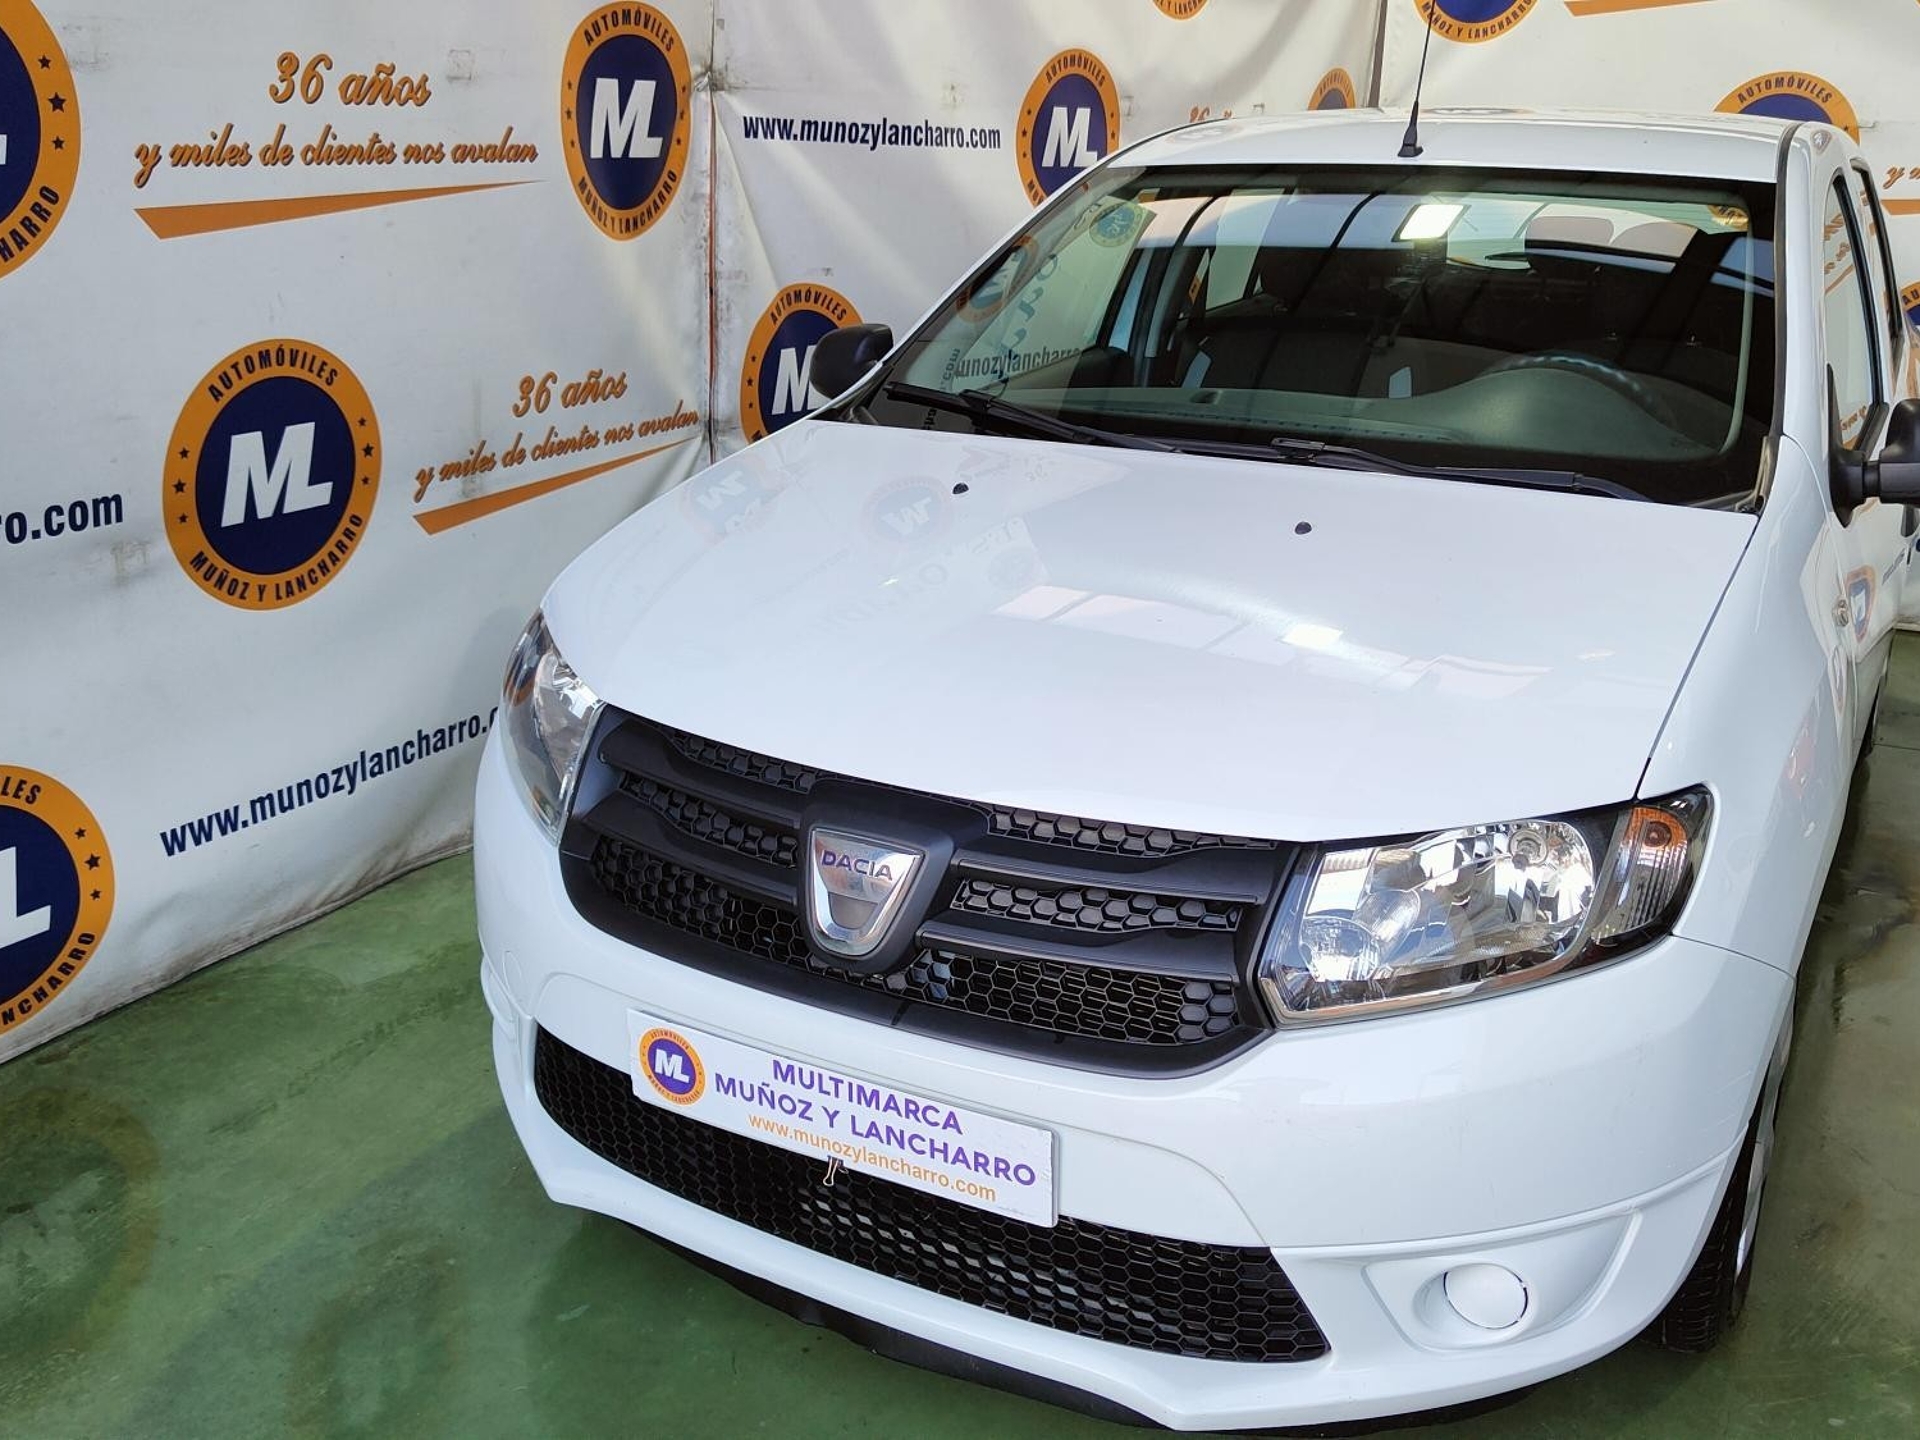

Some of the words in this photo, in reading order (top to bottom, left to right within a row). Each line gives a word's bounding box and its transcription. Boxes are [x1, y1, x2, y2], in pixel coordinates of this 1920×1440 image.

[584, 7, 674, 52] AUTOMÓVILES
[269, 51, 332, 104] 36
[338, 62, 431, 106] años
[1737, 74, 1832, 103] AUTOMÓVILES
[590, 77, 663, 159] ML
[743, 116, 1001, 151] www.munozylancharro.com
[1042, 106, 1098, 168] ML
[134, 142, 161, 188] y
[170, 122, 251, 167] miles
[259, 123, 293, 166] de
[300, 123, 397, 166] clientes
[403, 140, 445, 165] nos
[450, 125, 538, 164] avalan
[770, 286, 847, 326] AUTOMÓVILES
[208, 344, 339, 402] AUTOMÓVILES
[512, 372, 557, 417] 36
[561, 369, 627, 409] años
[221, 421, 333, 528] ML
[413, 465, 434, 502] y
[439, 439, 497, 481] miles
[502, 432, 526, 468] de
[531, 426, 600, 461] clientes
[604, 425, 635, 446] nos
[638, 399, 699, 438] avalan
[0, 494, 123, 544] o.com
[189, 551, 250, 601] MUÑOZ
[257, 584, 267, 602] Y
[275, 514, 363, 601] LANCHARRO
[821, 850, 893, 881] DACIA
[655, 1048, 690, 1084] ML
[772, 1059, 963, 1135] MULTIMARCA
[714, 1073, 813, 1122] MUÑOZ
[821, 1105, 841, 1129] Y
[851, 1115, 1036, 1187] LANCHARRO
[748, 1113, 997, 1202] www.munozylancharro.com
